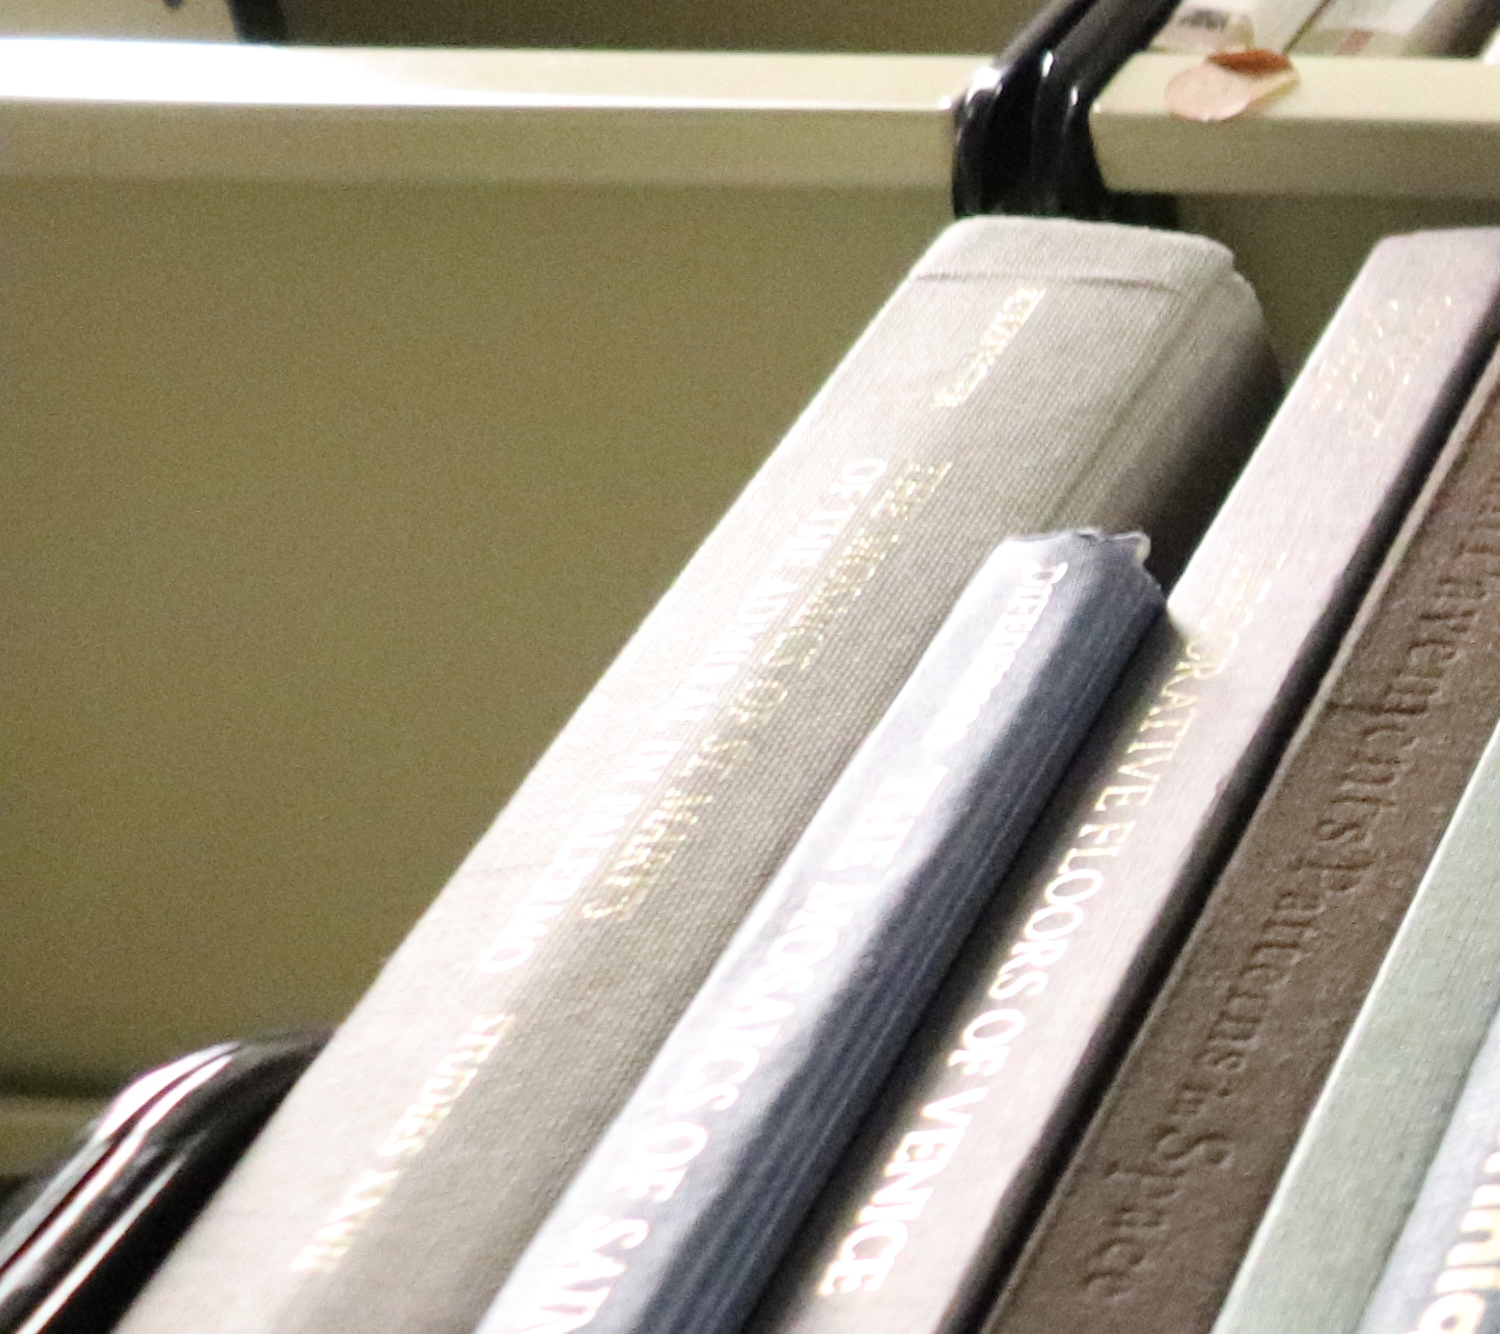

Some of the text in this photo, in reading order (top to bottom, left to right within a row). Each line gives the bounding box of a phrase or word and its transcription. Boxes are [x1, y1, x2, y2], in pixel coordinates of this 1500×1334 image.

[821, 763, 951, 874] THE
[970, 821, 1149, 999] FLOORS
[650, 878, 874, 1119] MOSAICS
[930, 1006, 1041, 1080] OF
[596, 1115, 720, 1206] OF
[800, 1087, 1003, 1297] VENICE
